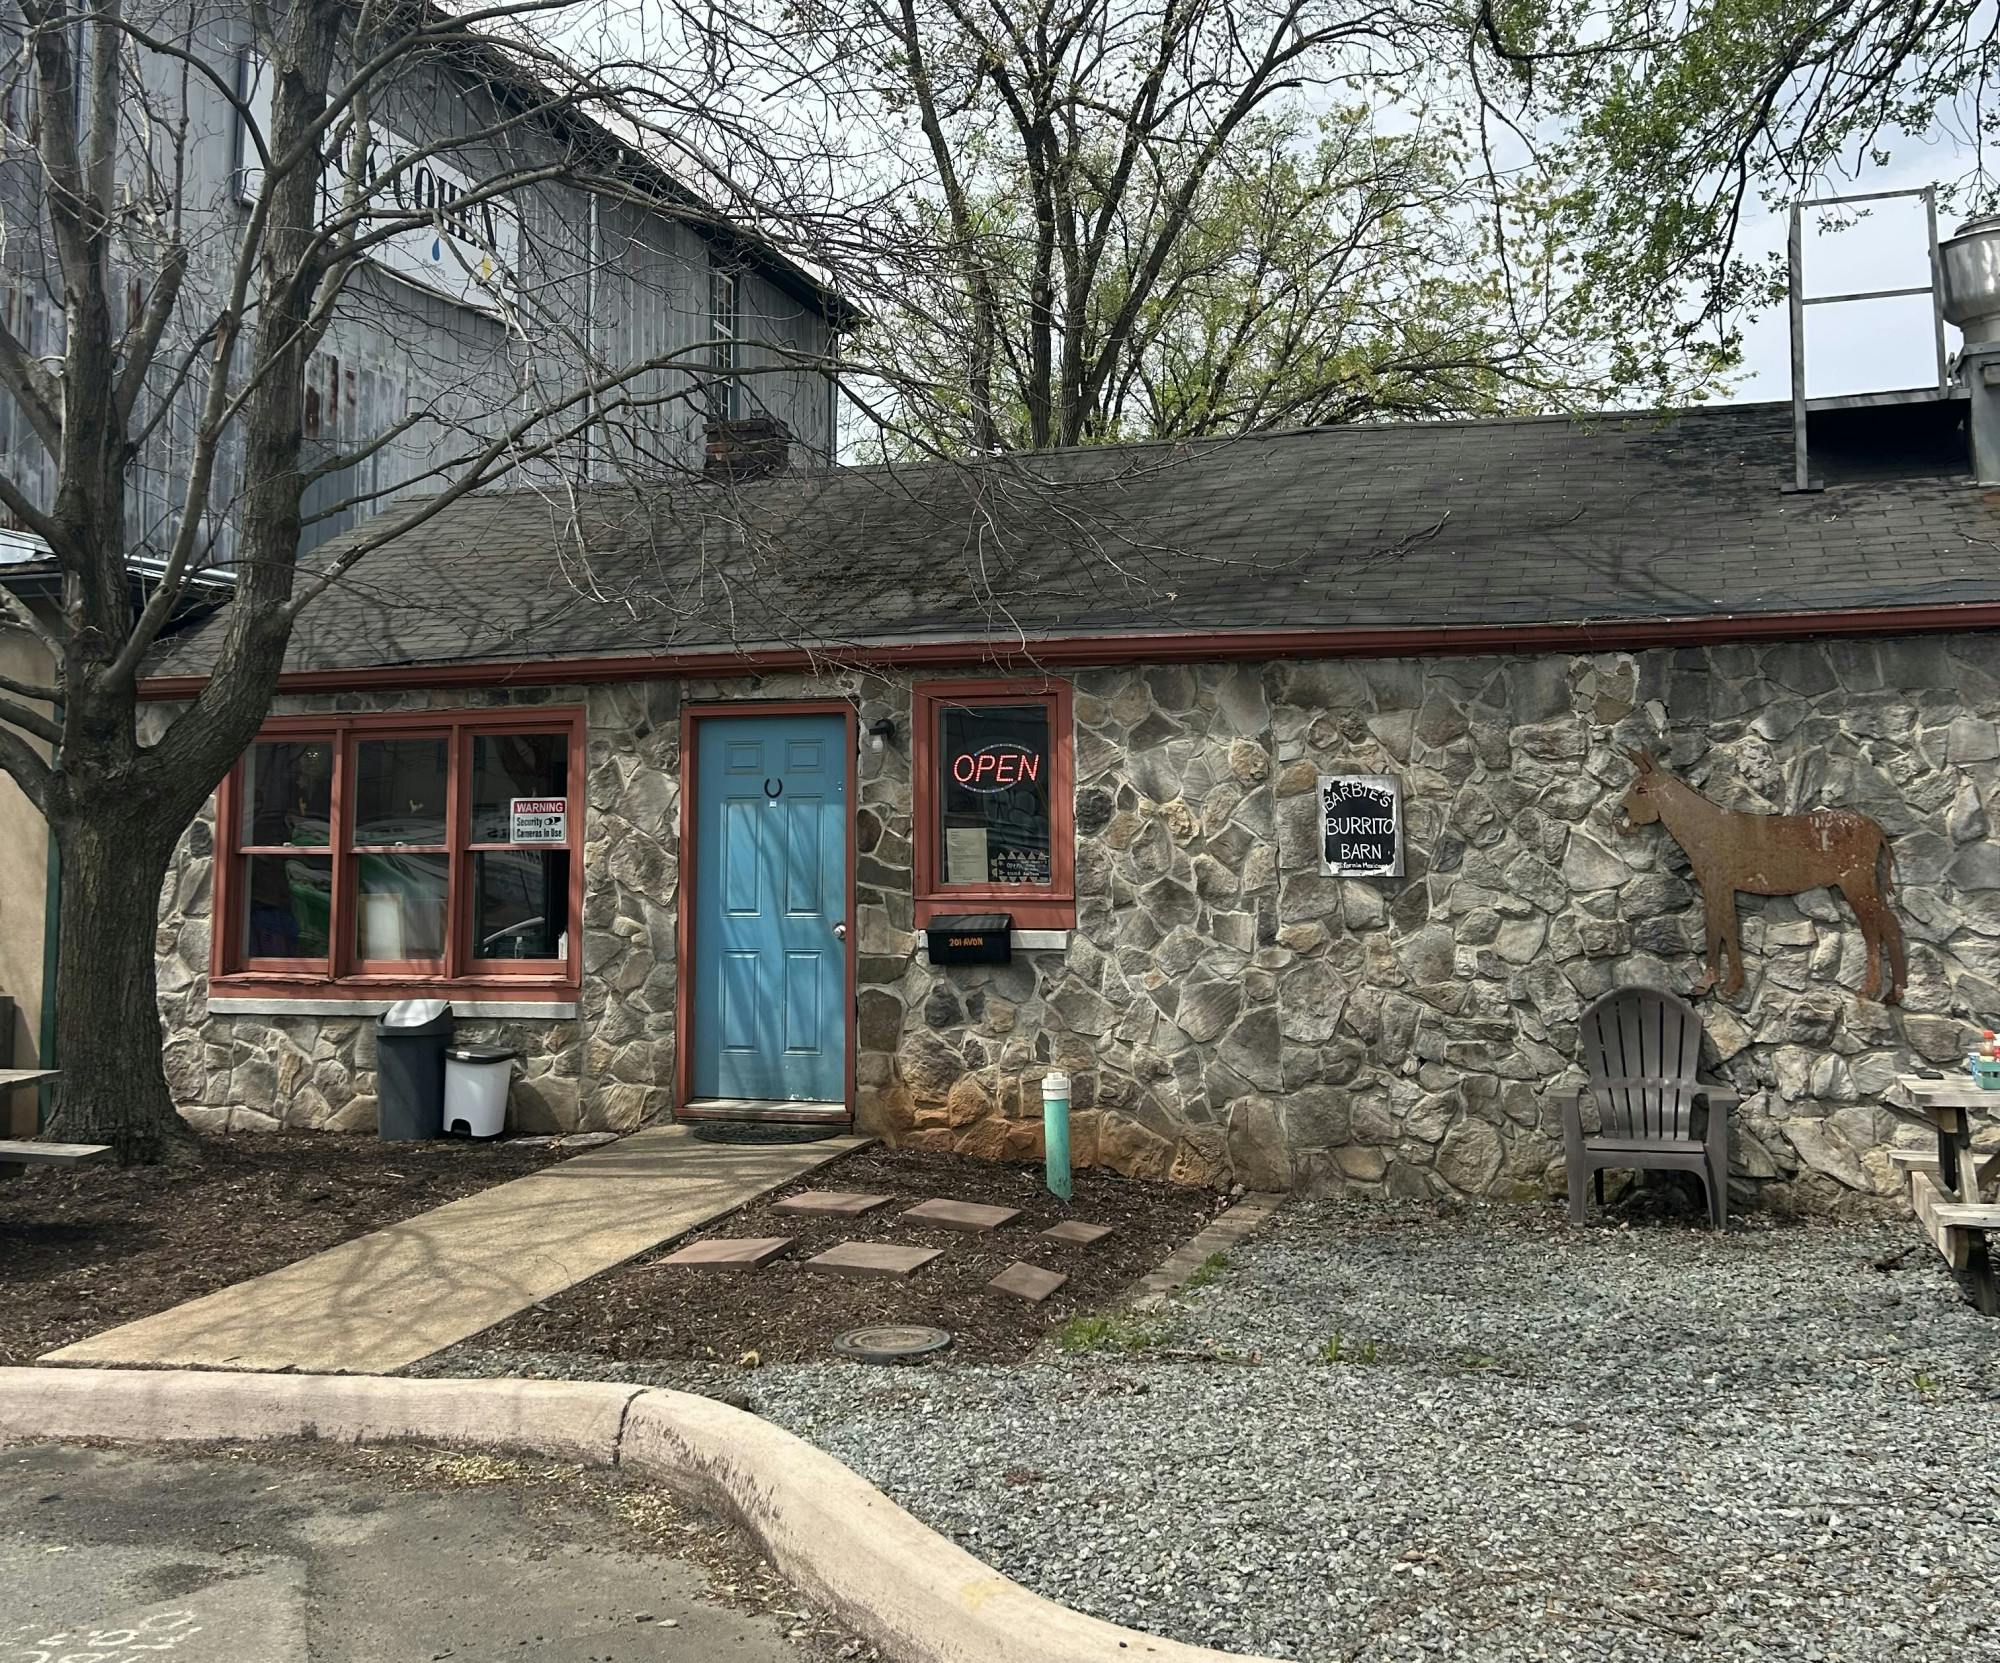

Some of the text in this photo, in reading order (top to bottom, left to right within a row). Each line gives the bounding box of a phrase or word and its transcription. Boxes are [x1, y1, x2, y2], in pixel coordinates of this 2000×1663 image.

[952, 754, 1040, 783] OPEN
[516, 802, 563, 812] WARNING
[516, 816, 543, 828] Security
[1326, 817, 1395, 836] BURRITO
[516, 828, 543, 838] Cameras
[550, 828, 562, 838] Use
[1340, 843, 1382, 860] BARN
[948, 937, 984, 947] 201 AVON
